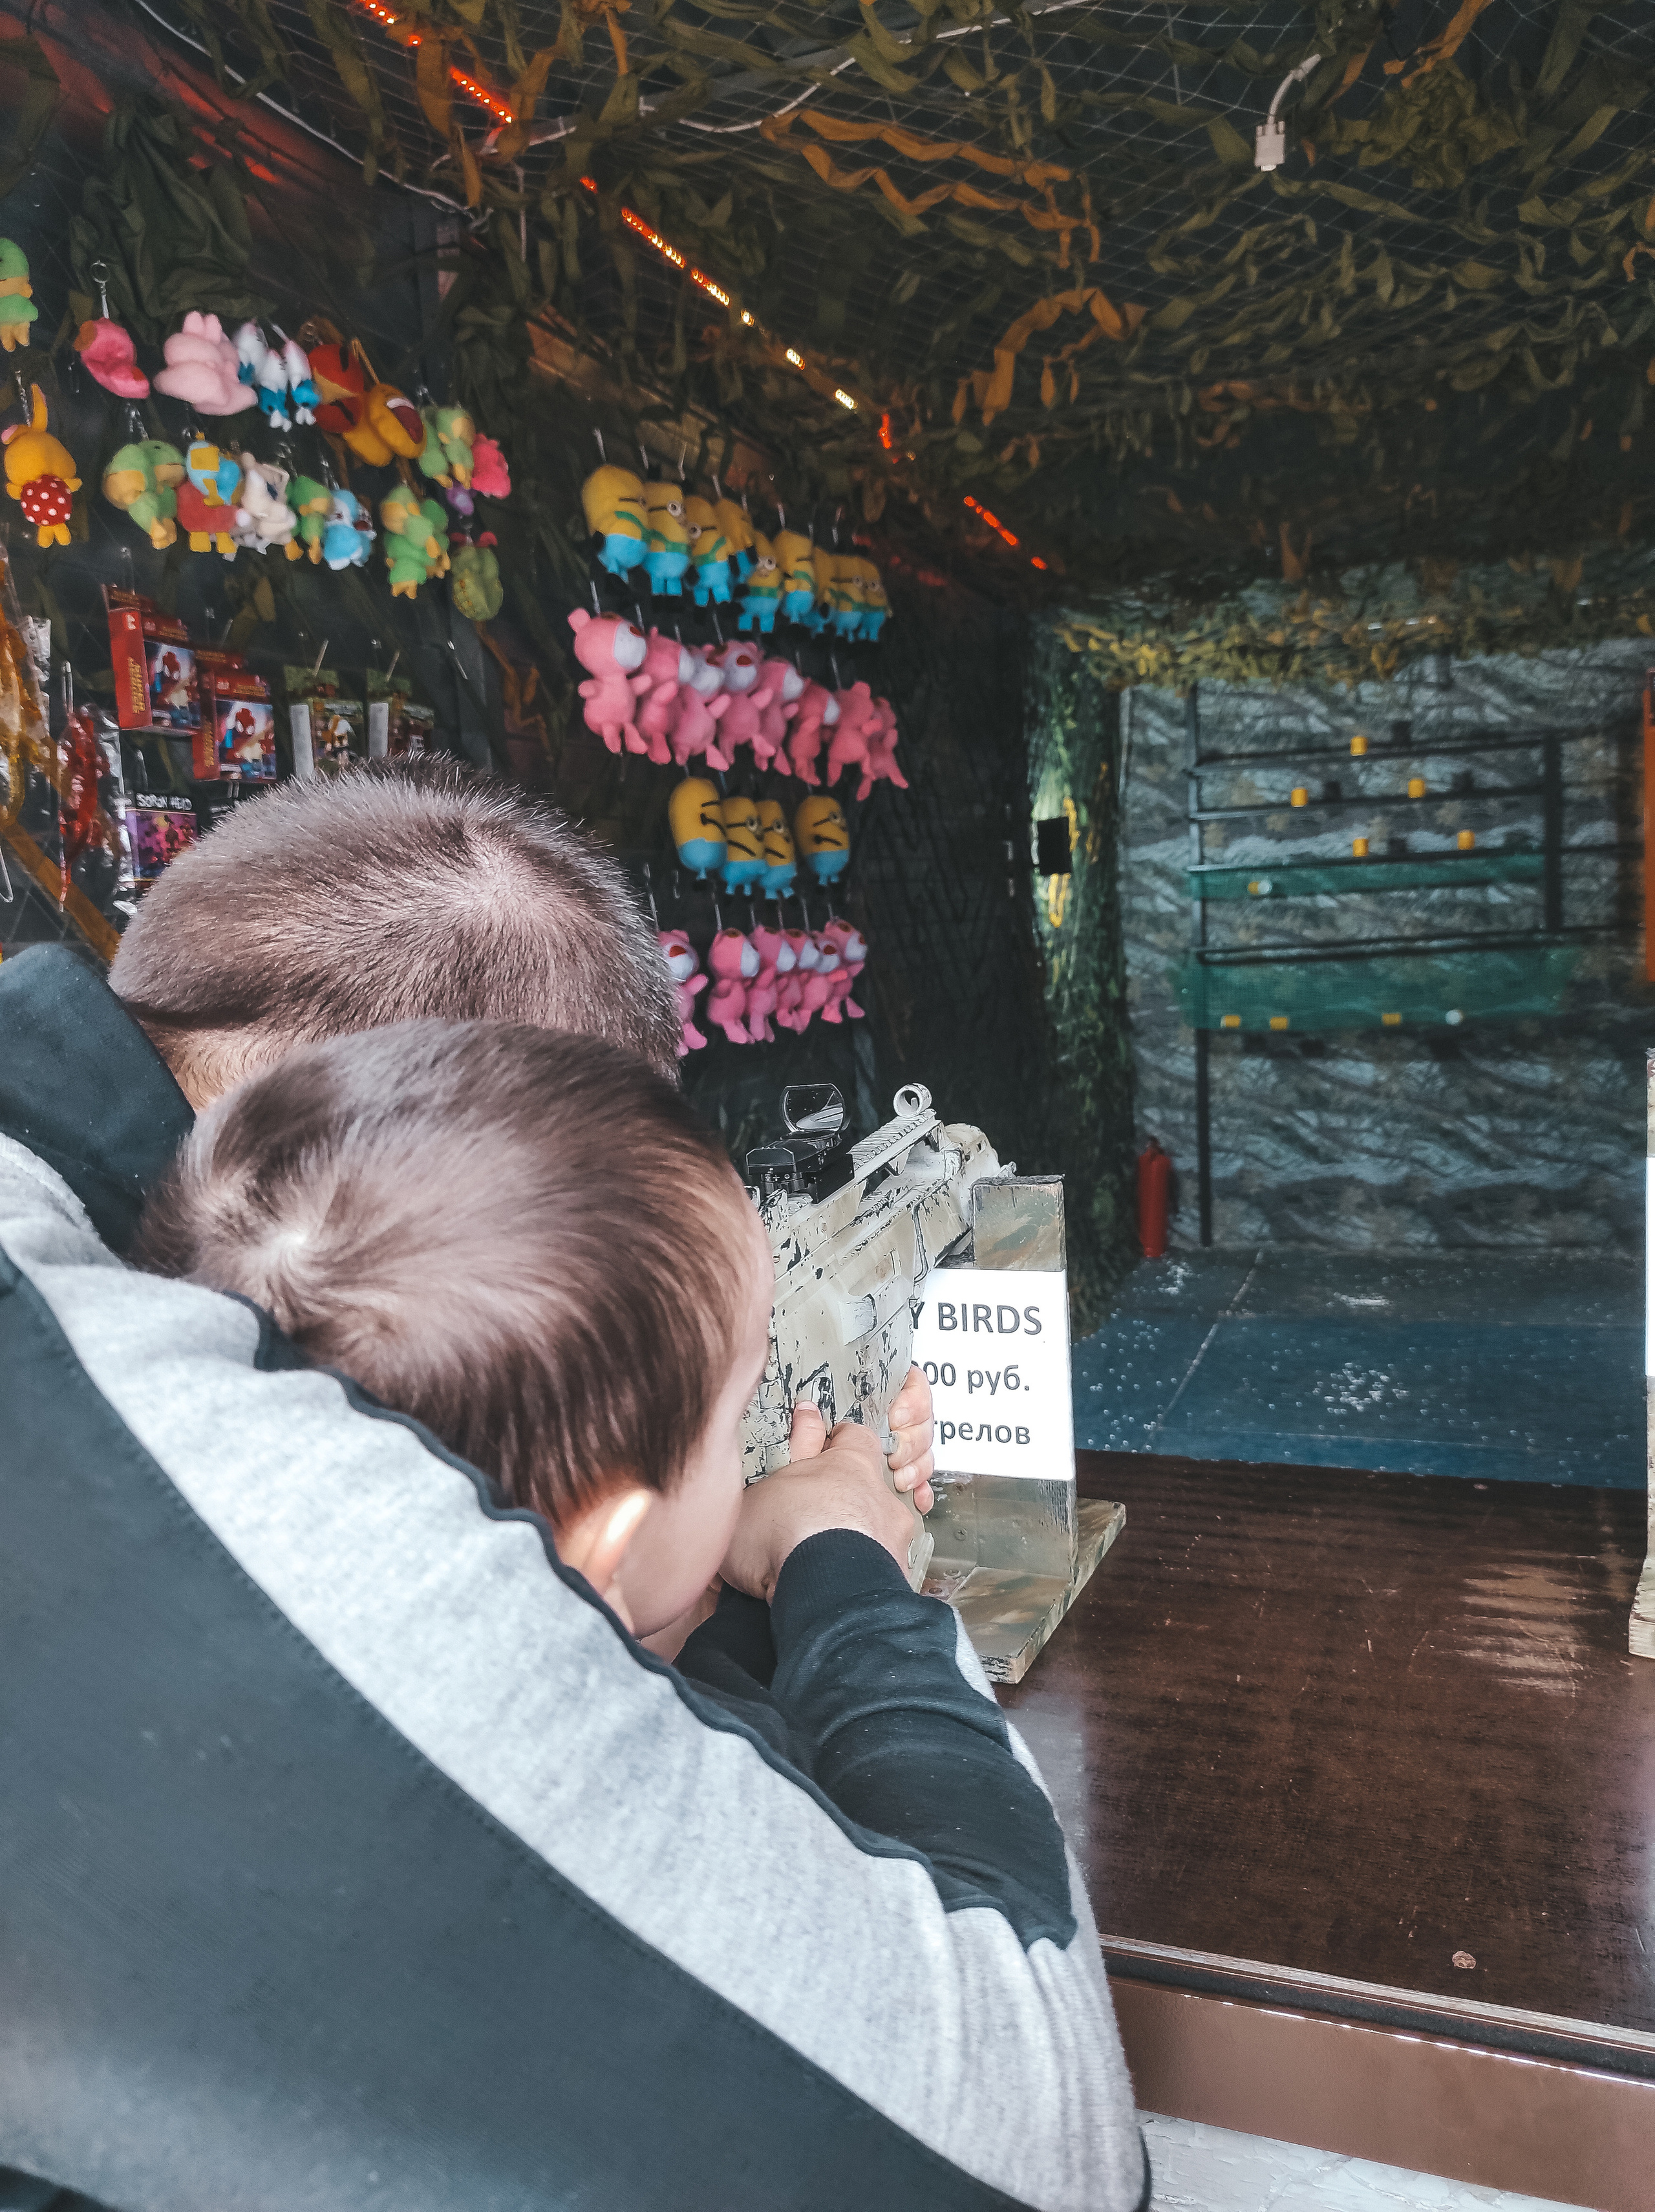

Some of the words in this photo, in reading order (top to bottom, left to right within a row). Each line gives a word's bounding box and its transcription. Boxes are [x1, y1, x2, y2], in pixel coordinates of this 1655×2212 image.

[938, 1302, 1042, 1335] BIRDS
[911, 1360, 956, 1386] 00
[967, 1364, 1030, 1395] руб.
[934, 1420, 1030, 1445] релов
